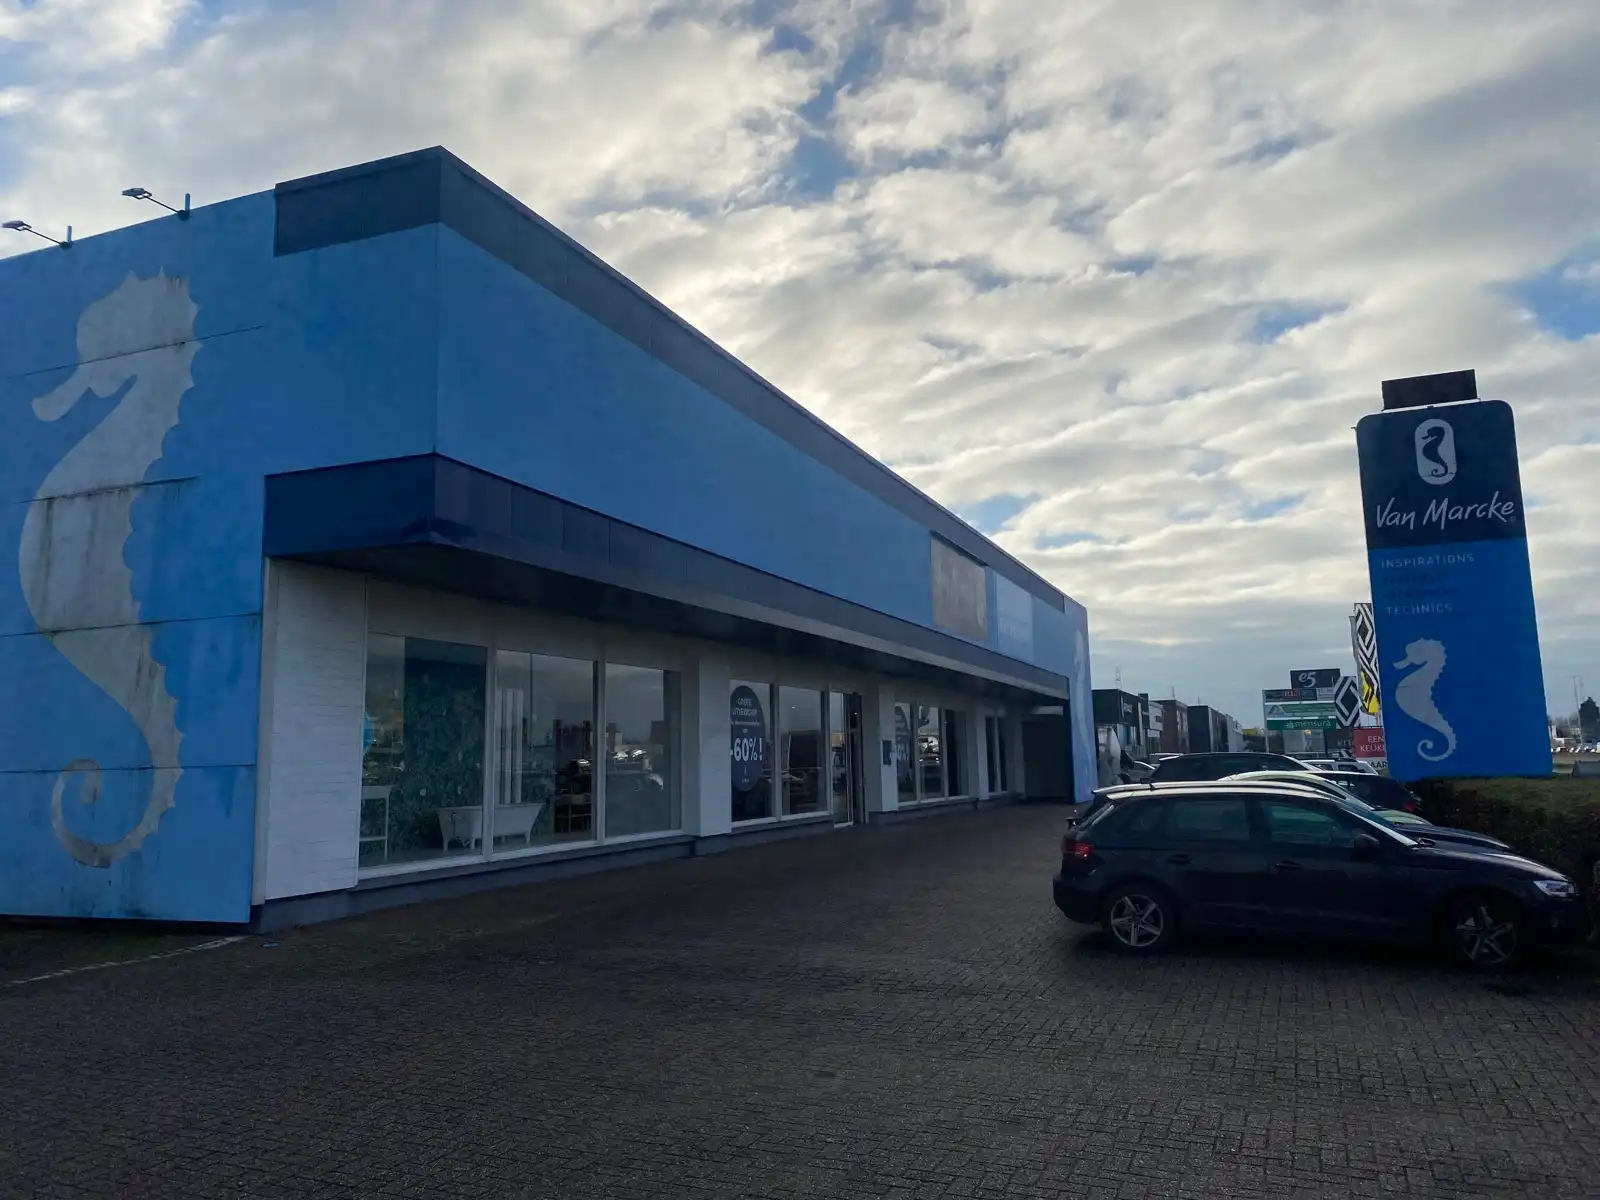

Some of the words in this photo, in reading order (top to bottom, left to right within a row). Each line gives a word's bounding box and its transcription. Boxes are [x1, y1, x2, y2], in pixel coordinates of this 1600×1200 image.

[1376, 497, 1416, 530] Van
[1422, 491, 1514, 530] Marcke
[1381, 553, 1475, 569] INSPIRATIONS
[1386, 603, 1452, 616] TECHNICS
[1299, 671, 1316, 688] e5
[1295, 720, 1331, 728] mensura
